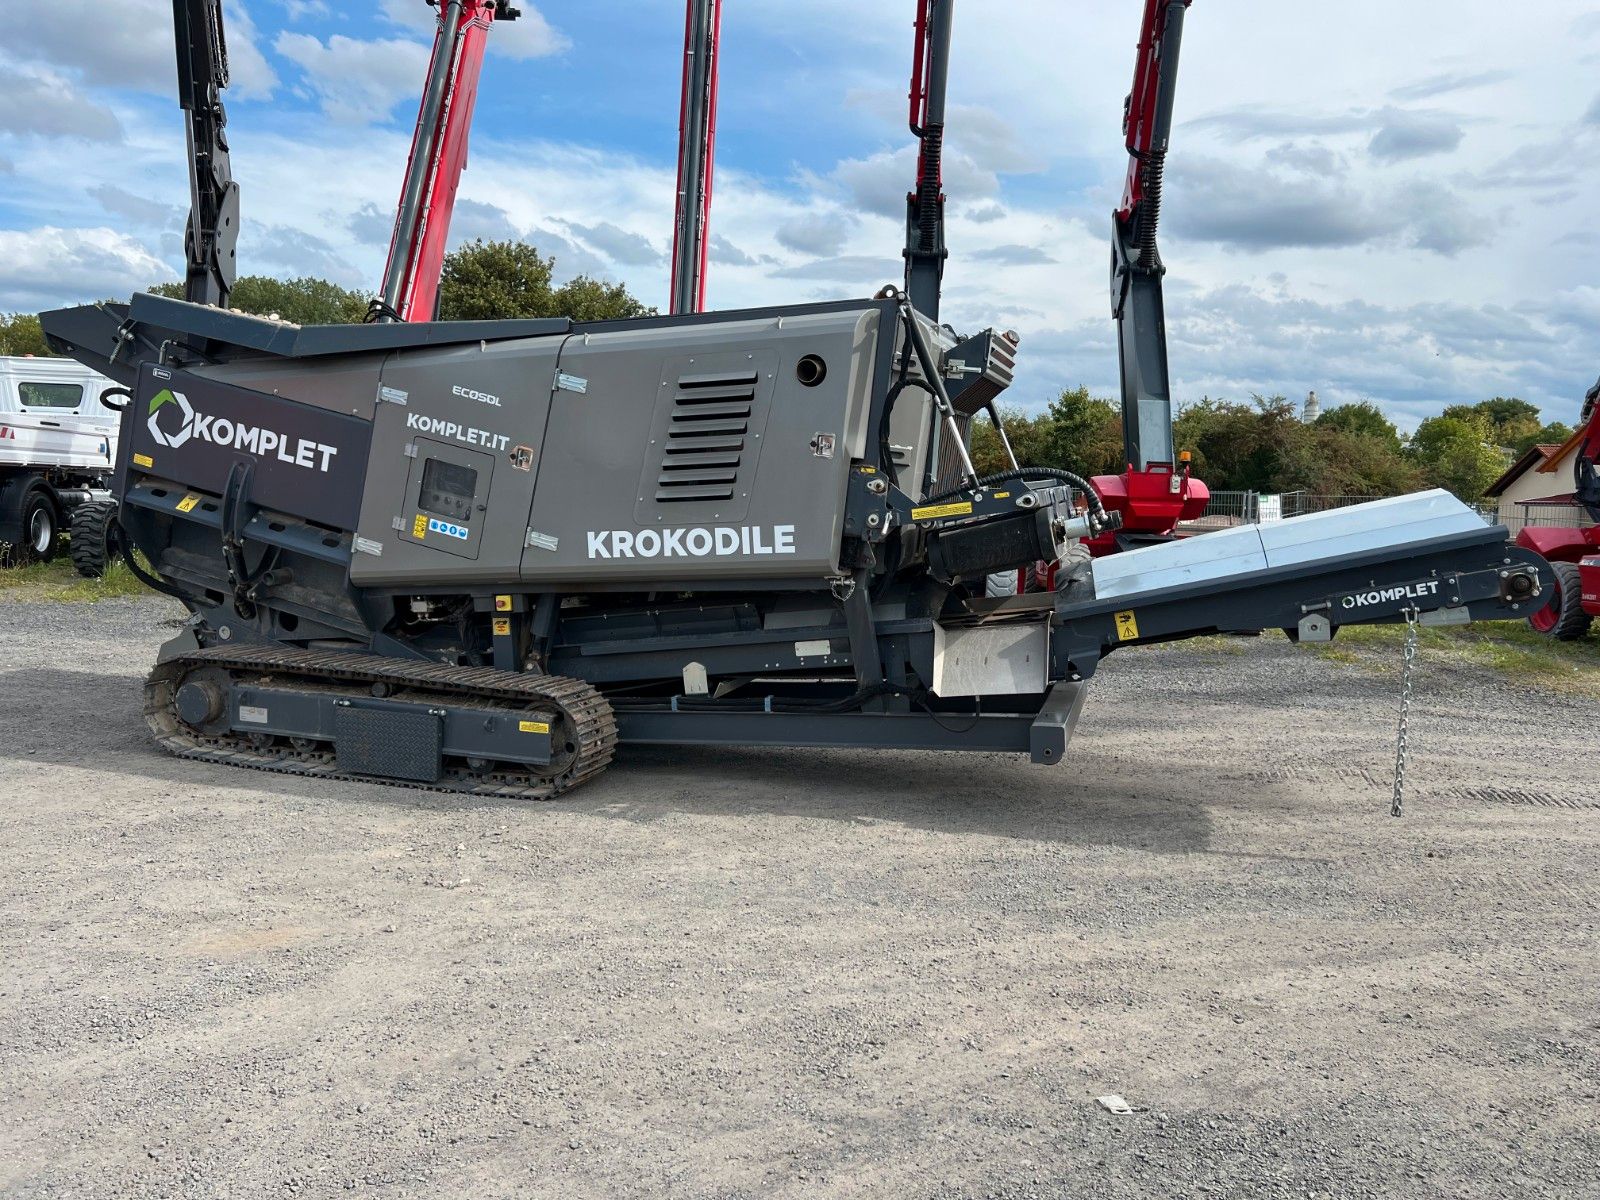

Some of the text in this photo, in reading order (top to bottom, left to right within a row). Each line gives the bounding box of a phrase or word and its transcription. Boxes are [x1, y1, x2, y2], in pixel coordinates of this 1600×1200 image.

[192, 413, 337, 472] KOMPLET
[406, 413, 510, 451] KOMPLET.IT
[587, 525, 795, 559] KROKODILE
[1356, 581, 1439, 606] KOMPLET
